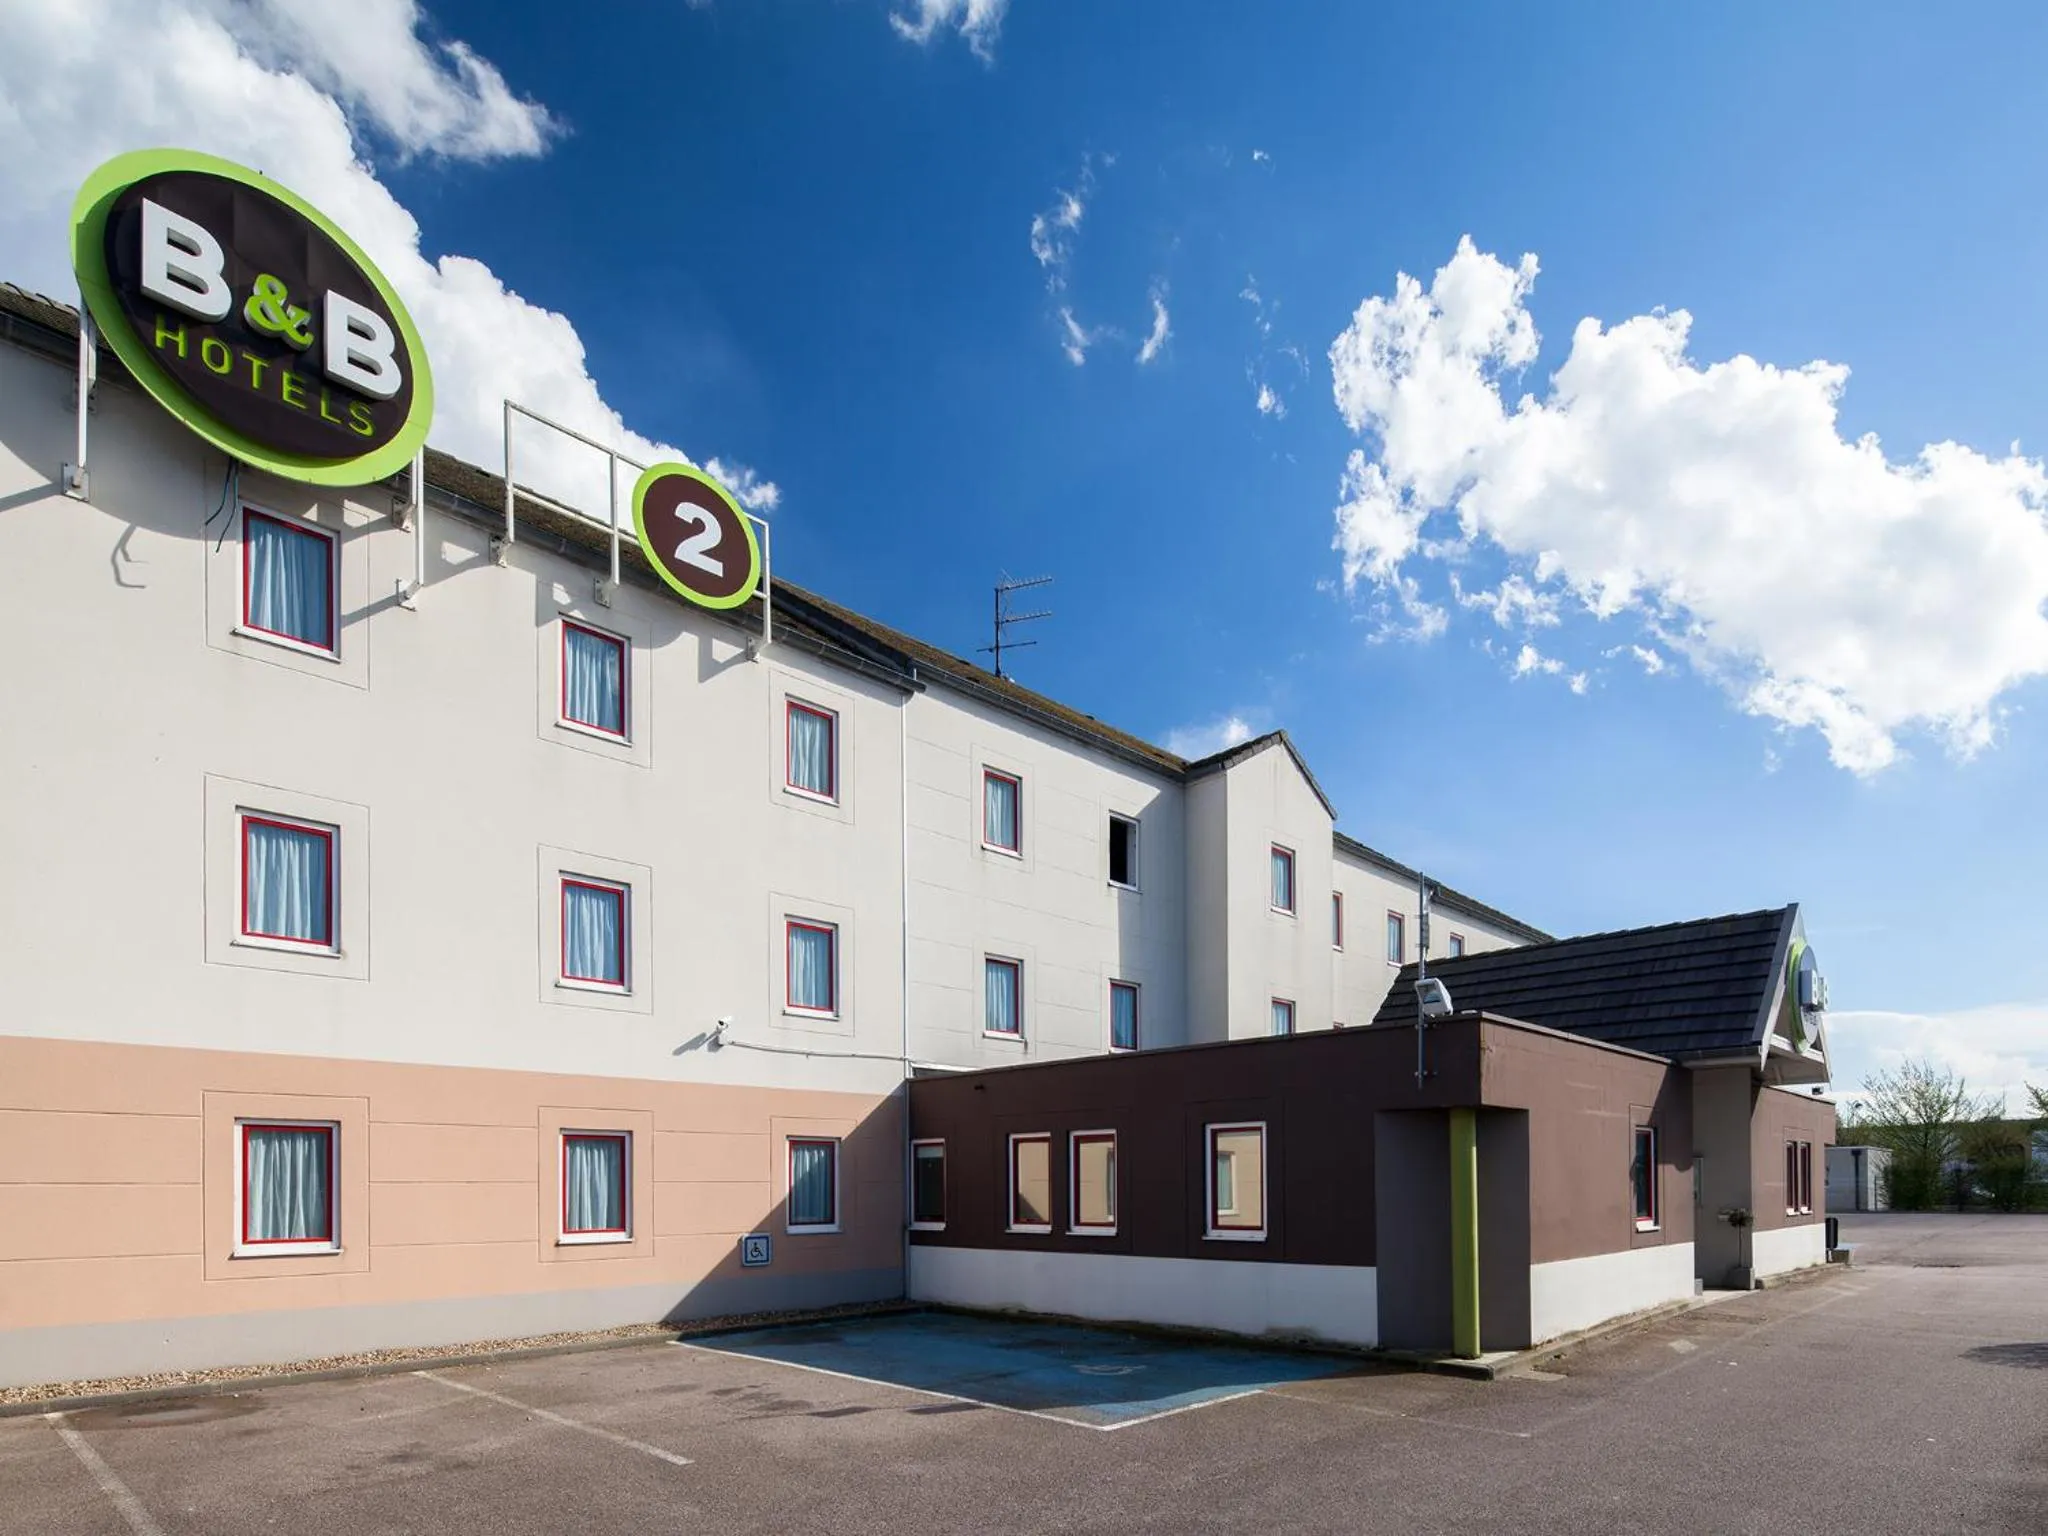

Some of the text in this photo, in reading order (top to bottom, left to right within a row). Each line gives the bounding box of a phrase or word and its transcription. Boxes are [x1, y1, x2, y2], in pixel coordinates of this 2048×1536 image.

[141, 198, 402, 400] B&B
[155, 314, 376, 438] HOTELS
[674, 501, 724, 578] 2
